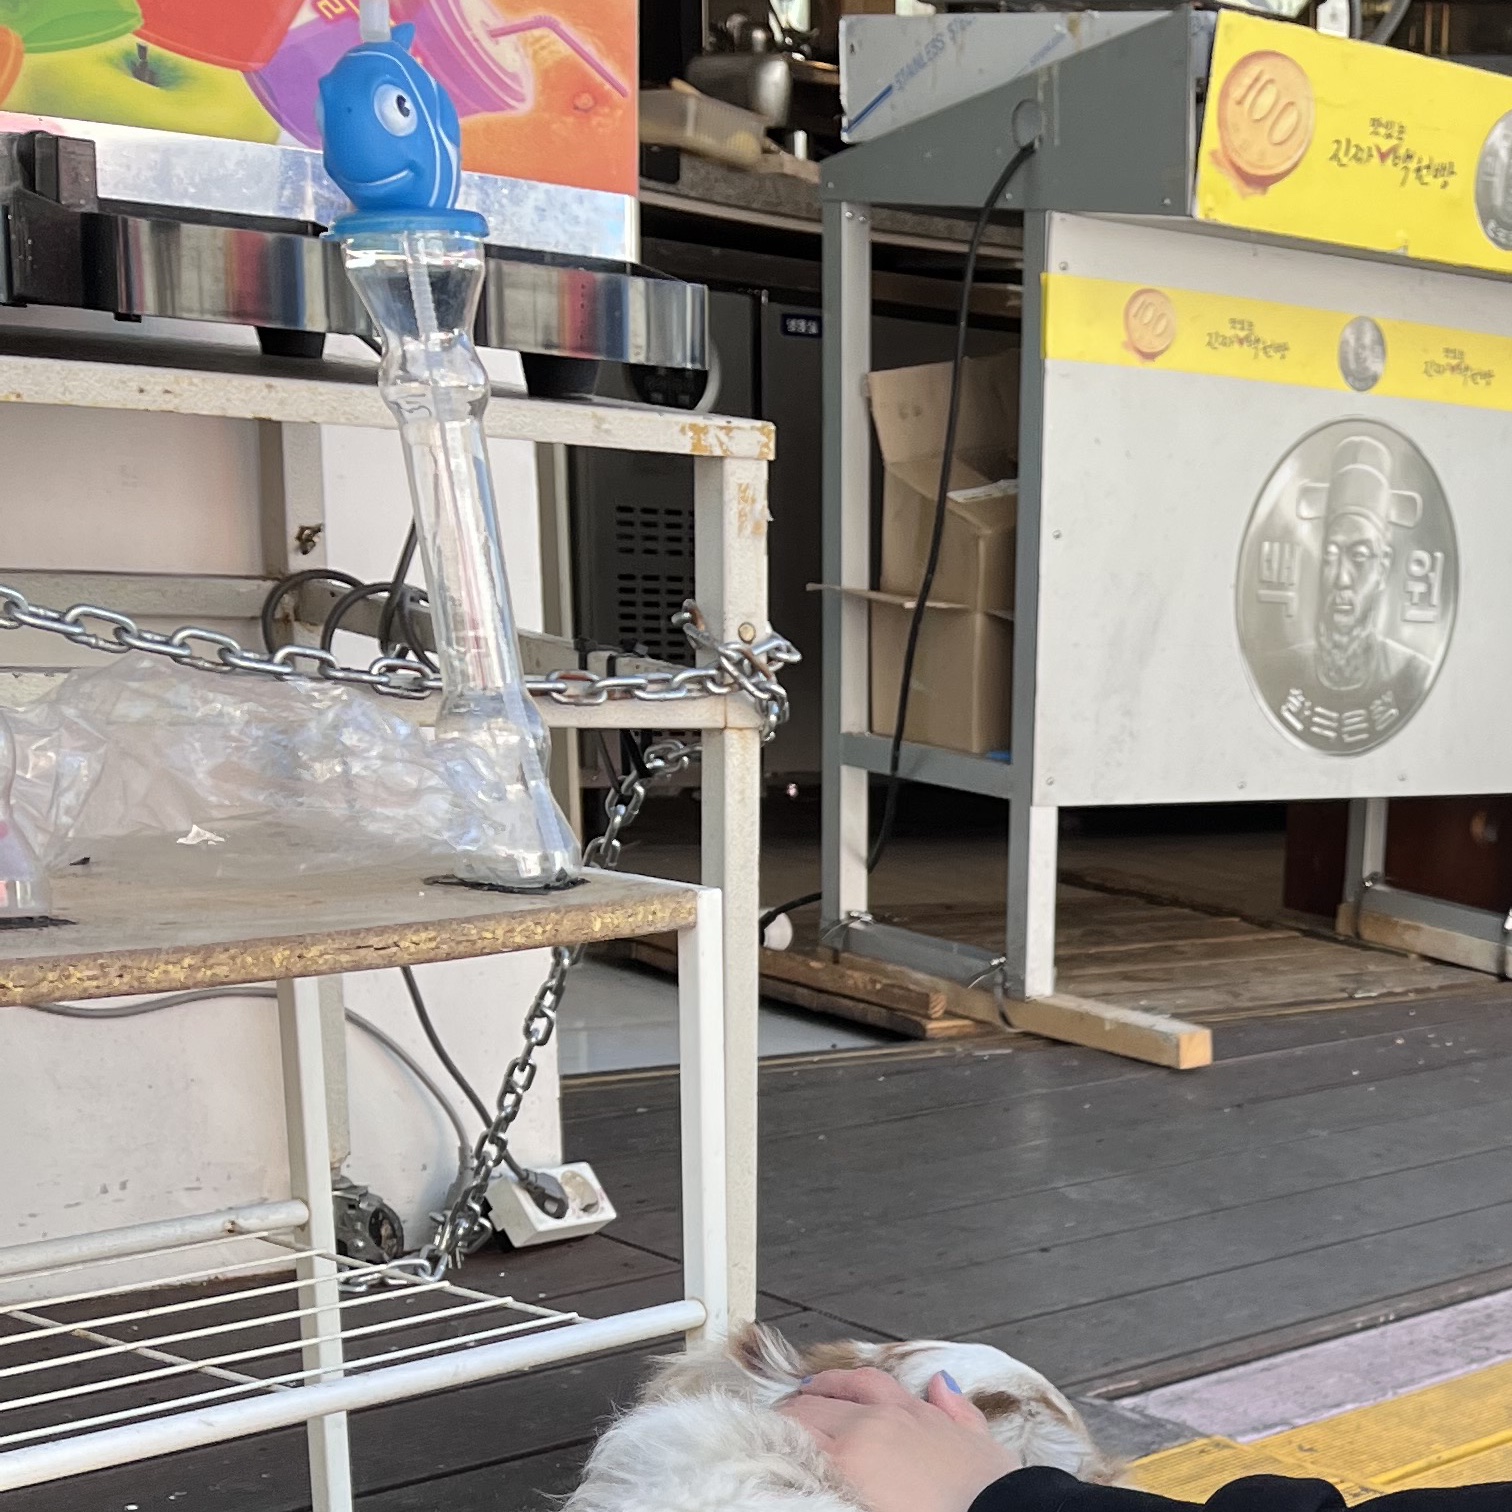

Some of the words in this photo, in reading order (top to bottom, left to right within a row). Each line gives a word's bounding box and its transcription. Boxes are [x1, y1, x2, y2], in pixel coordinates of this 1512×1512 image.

[1257, 541, 1298, 618] 백
[1401, 550, 1445, 624] 원
[1280, 688, 1399, 743] 한국은행
